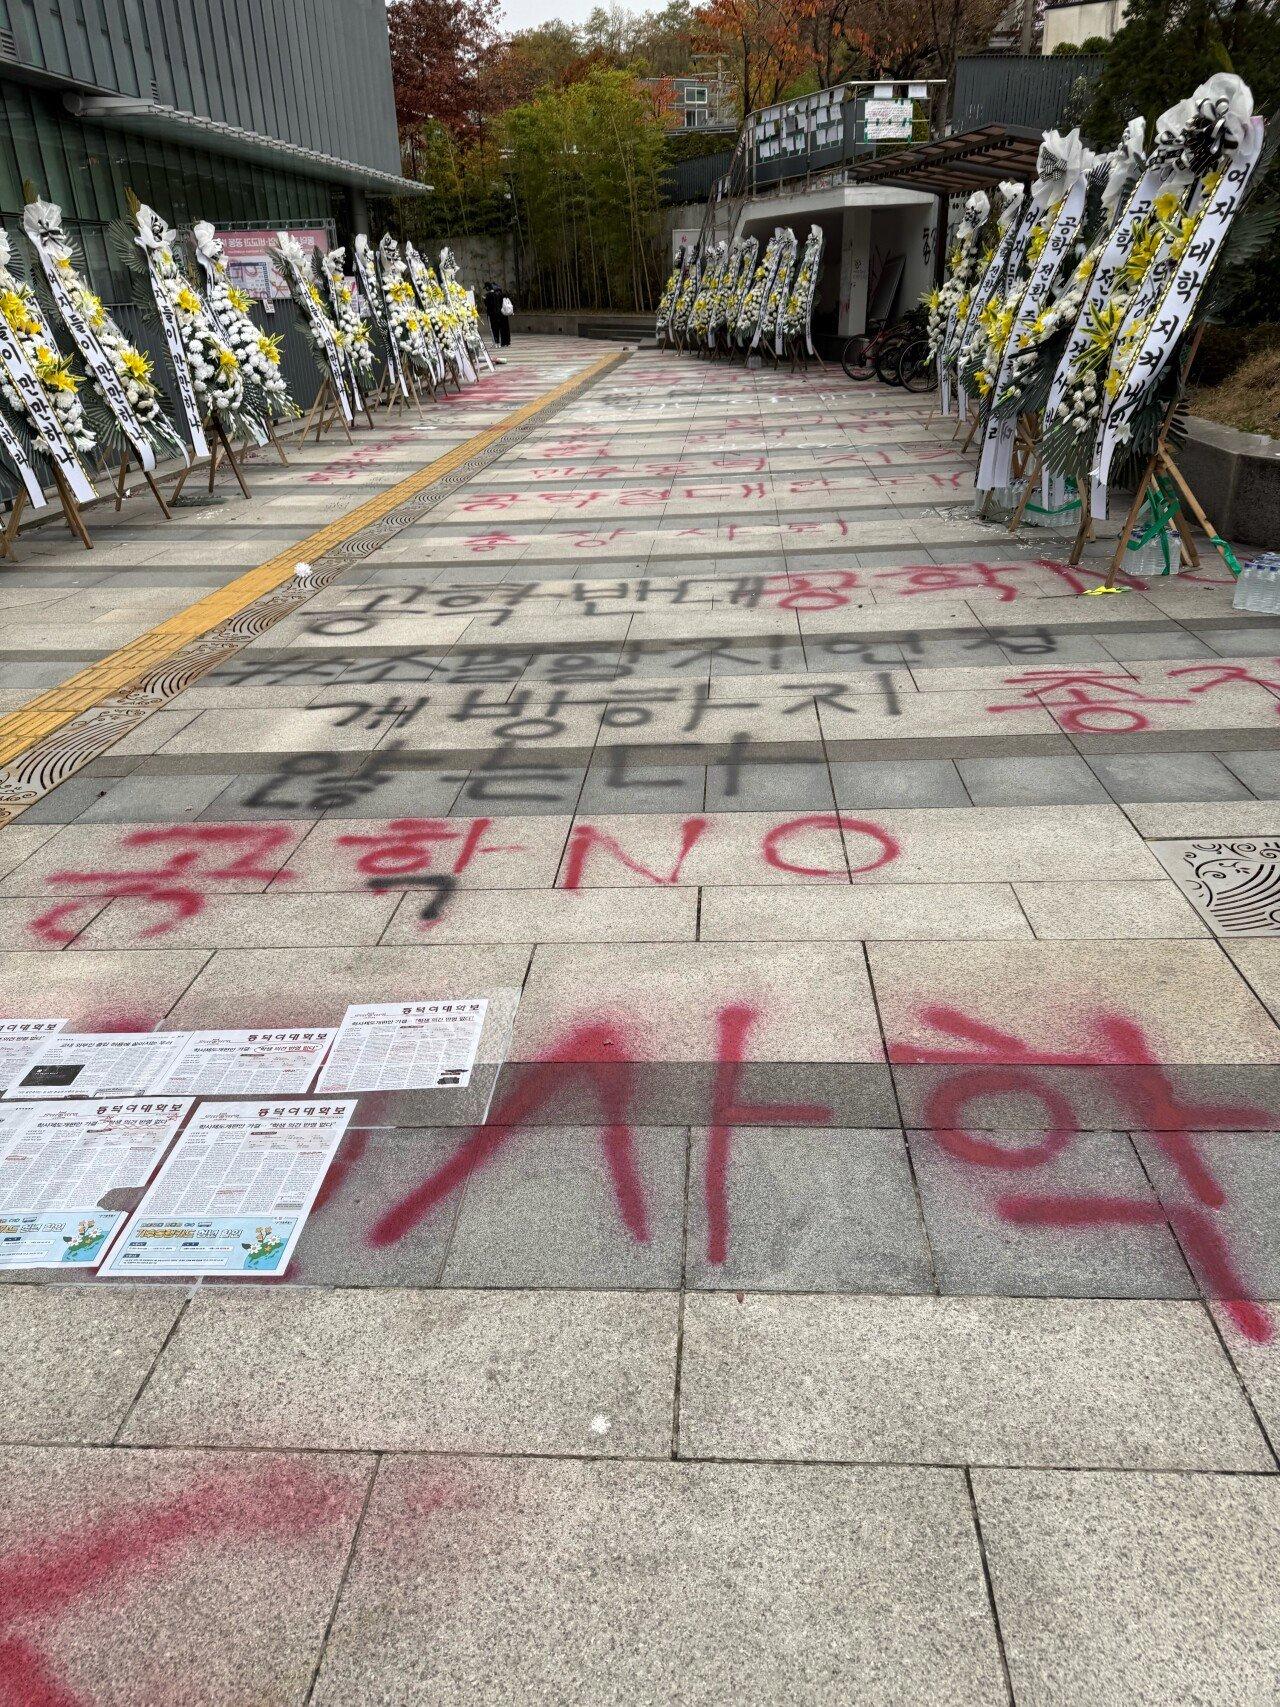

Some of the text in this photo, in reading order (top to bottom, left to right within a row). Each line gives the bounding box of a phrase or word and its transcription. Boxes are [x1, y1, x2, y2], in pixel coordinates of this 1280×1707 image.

[1050, 215, 1078, 256] 공학
[1028, 262, 1055, 304] 전환
[47, 272, 147, 447] 여자들이 만만하냐
[173, 352, 201, 434] 만만하냐
[16, 372, 76, 468] 만만하냐
[463, 526, 642, 554] 총장
[297, 670, 908, 743] 개방하지
[240, 732, 832, 810] 않는다
[28, 816, 524, 946] 공학
[555, 814, 902, 892] NO
[247, 1032, 328, 1042] 동덕여대학보
[401, 1003, 481, 1015] 동덕여대학보
[96, 1103, 184, 1115] 동덕여대학보
[257, 1106, 347, 1117] 동덕여대학보
[365, 1000, 1280, 1348] 사학
